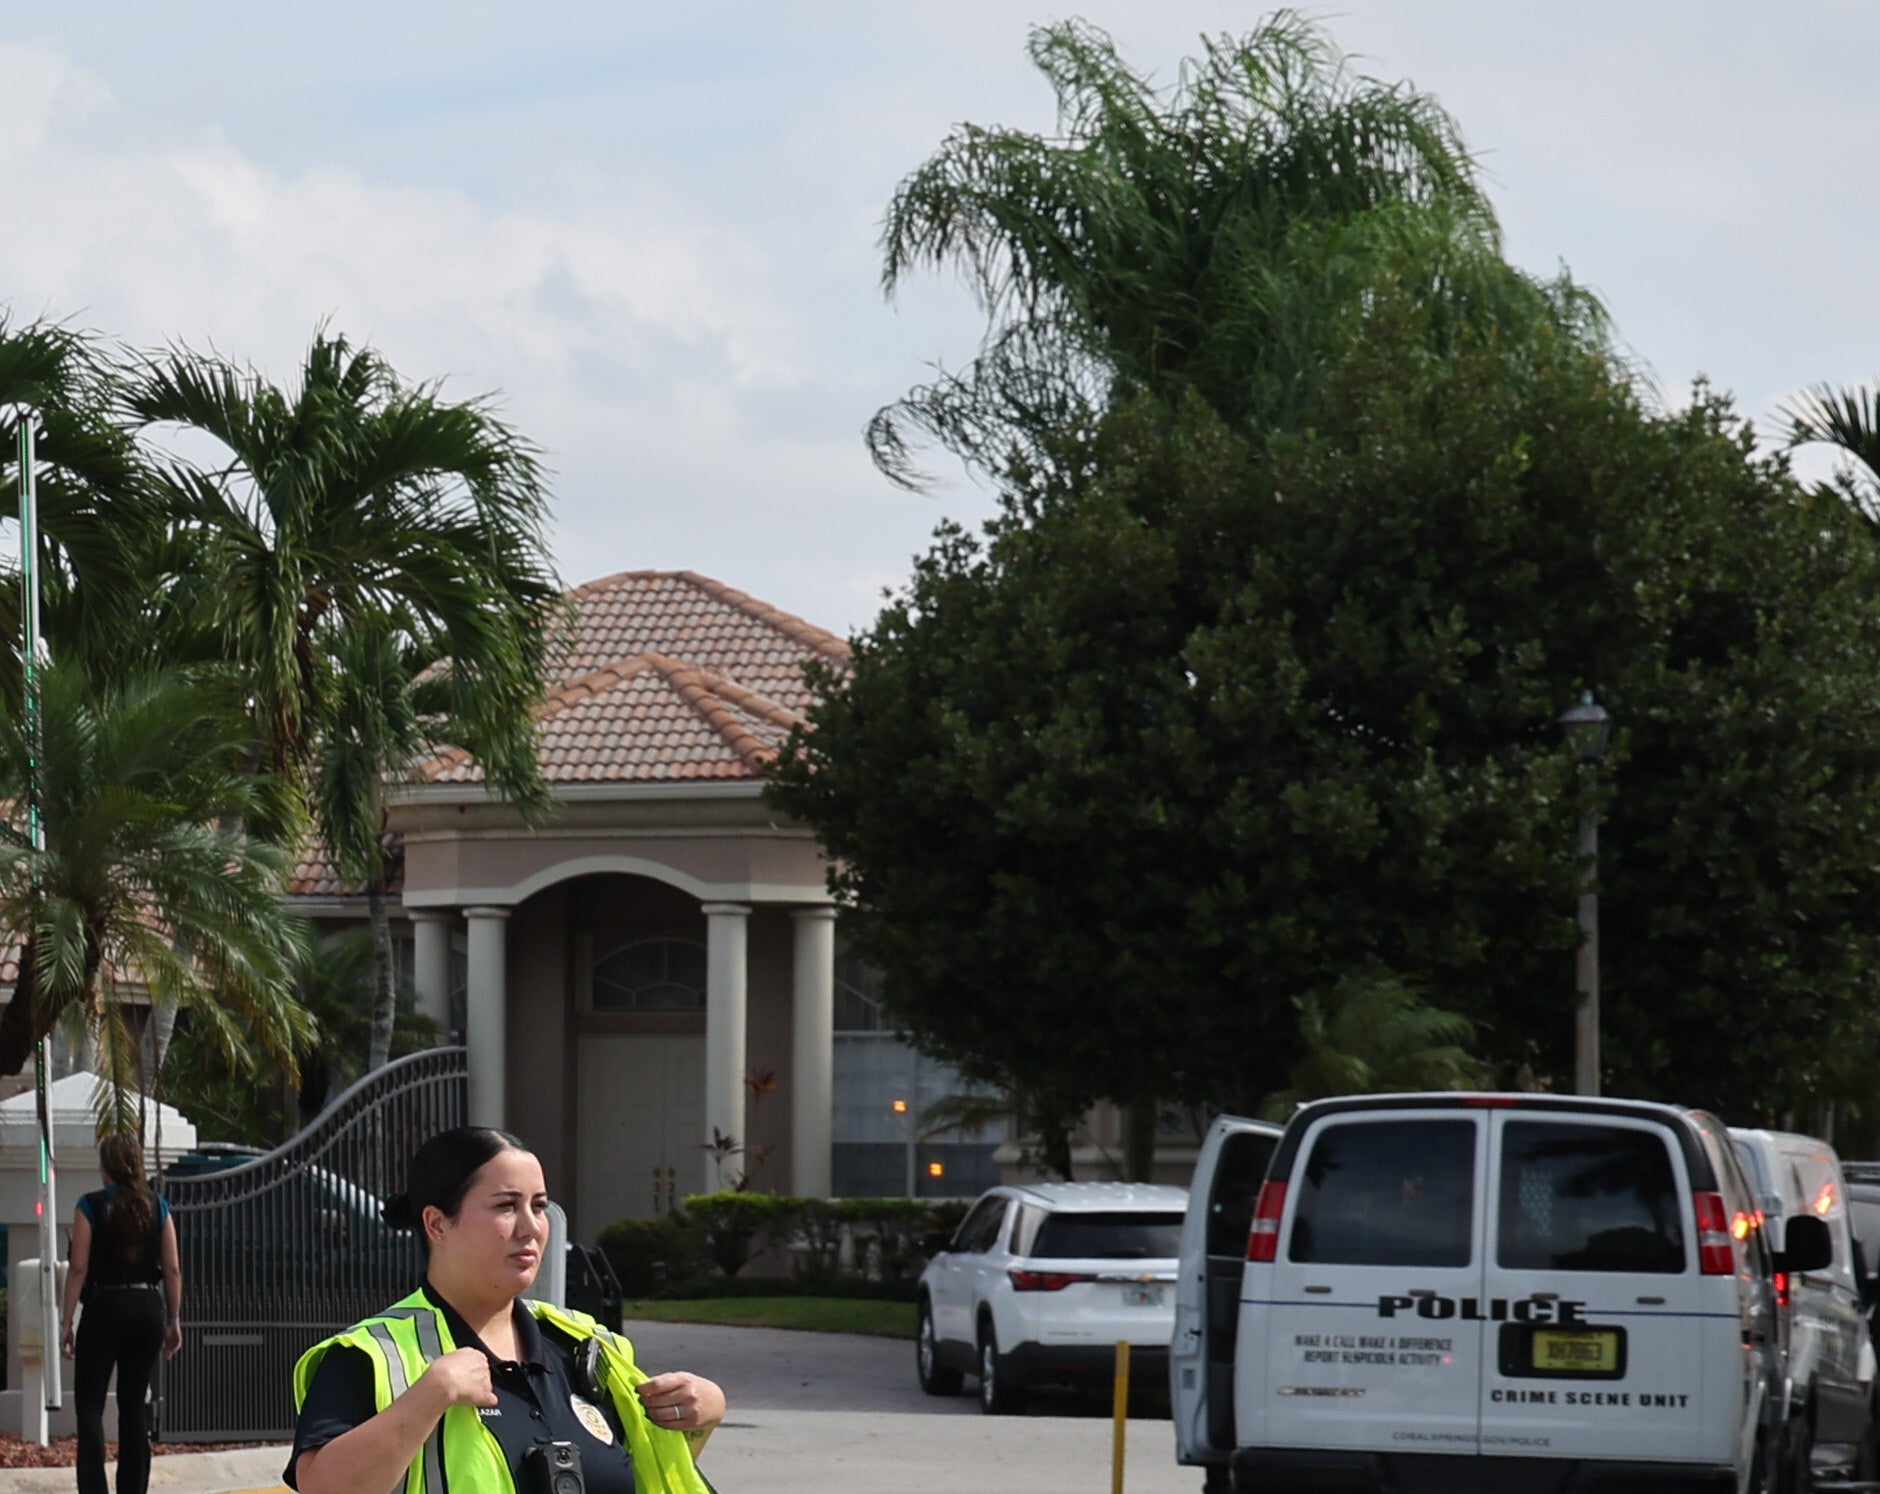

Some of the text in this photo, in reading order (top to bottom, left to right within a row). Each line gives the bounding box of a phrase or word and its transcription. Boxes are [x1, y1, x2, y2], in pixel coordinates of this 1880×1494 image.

[1378, 1295, 1588, 1323] POLICE
[1491, 1389, 1689, 1408] CRIME SCENE UNIT
